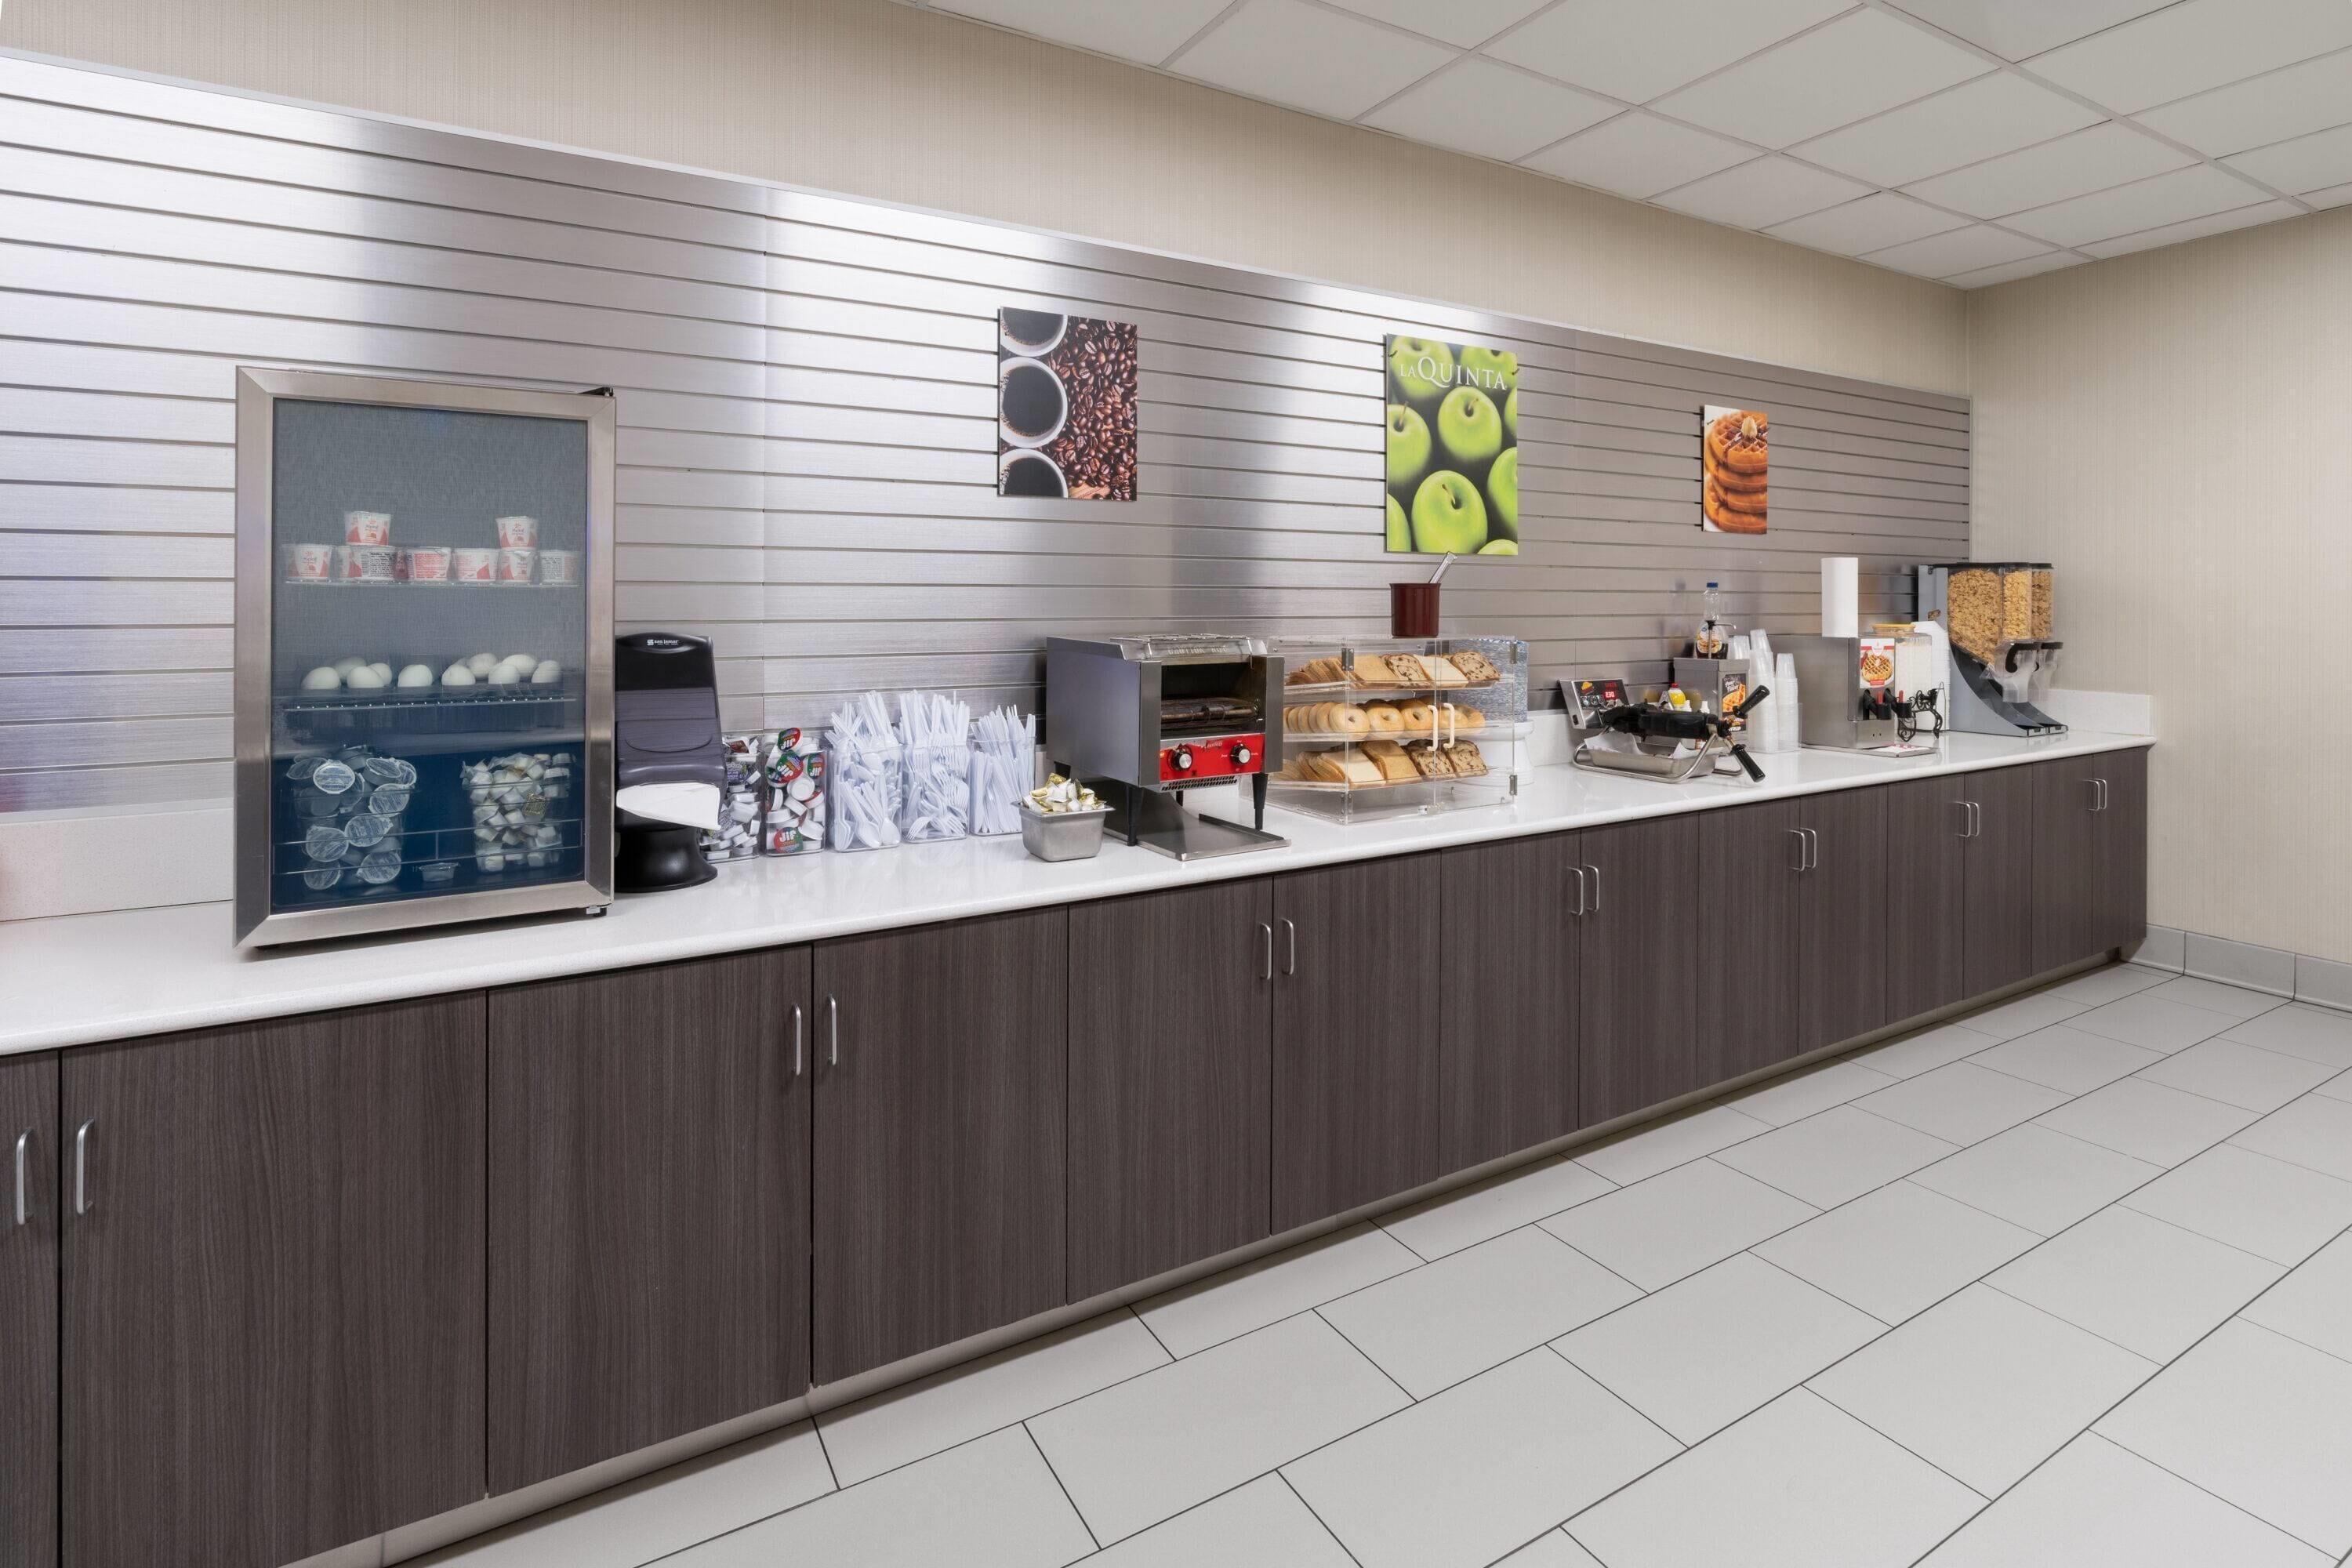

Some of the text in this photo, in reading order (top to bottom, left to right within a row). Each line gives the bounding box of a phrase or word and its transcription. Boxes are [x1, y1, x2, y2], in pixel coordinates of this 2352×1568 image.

[1400, 357, 1506, 390] LA QUINTA
[779, 830, 797, 842] Jif
